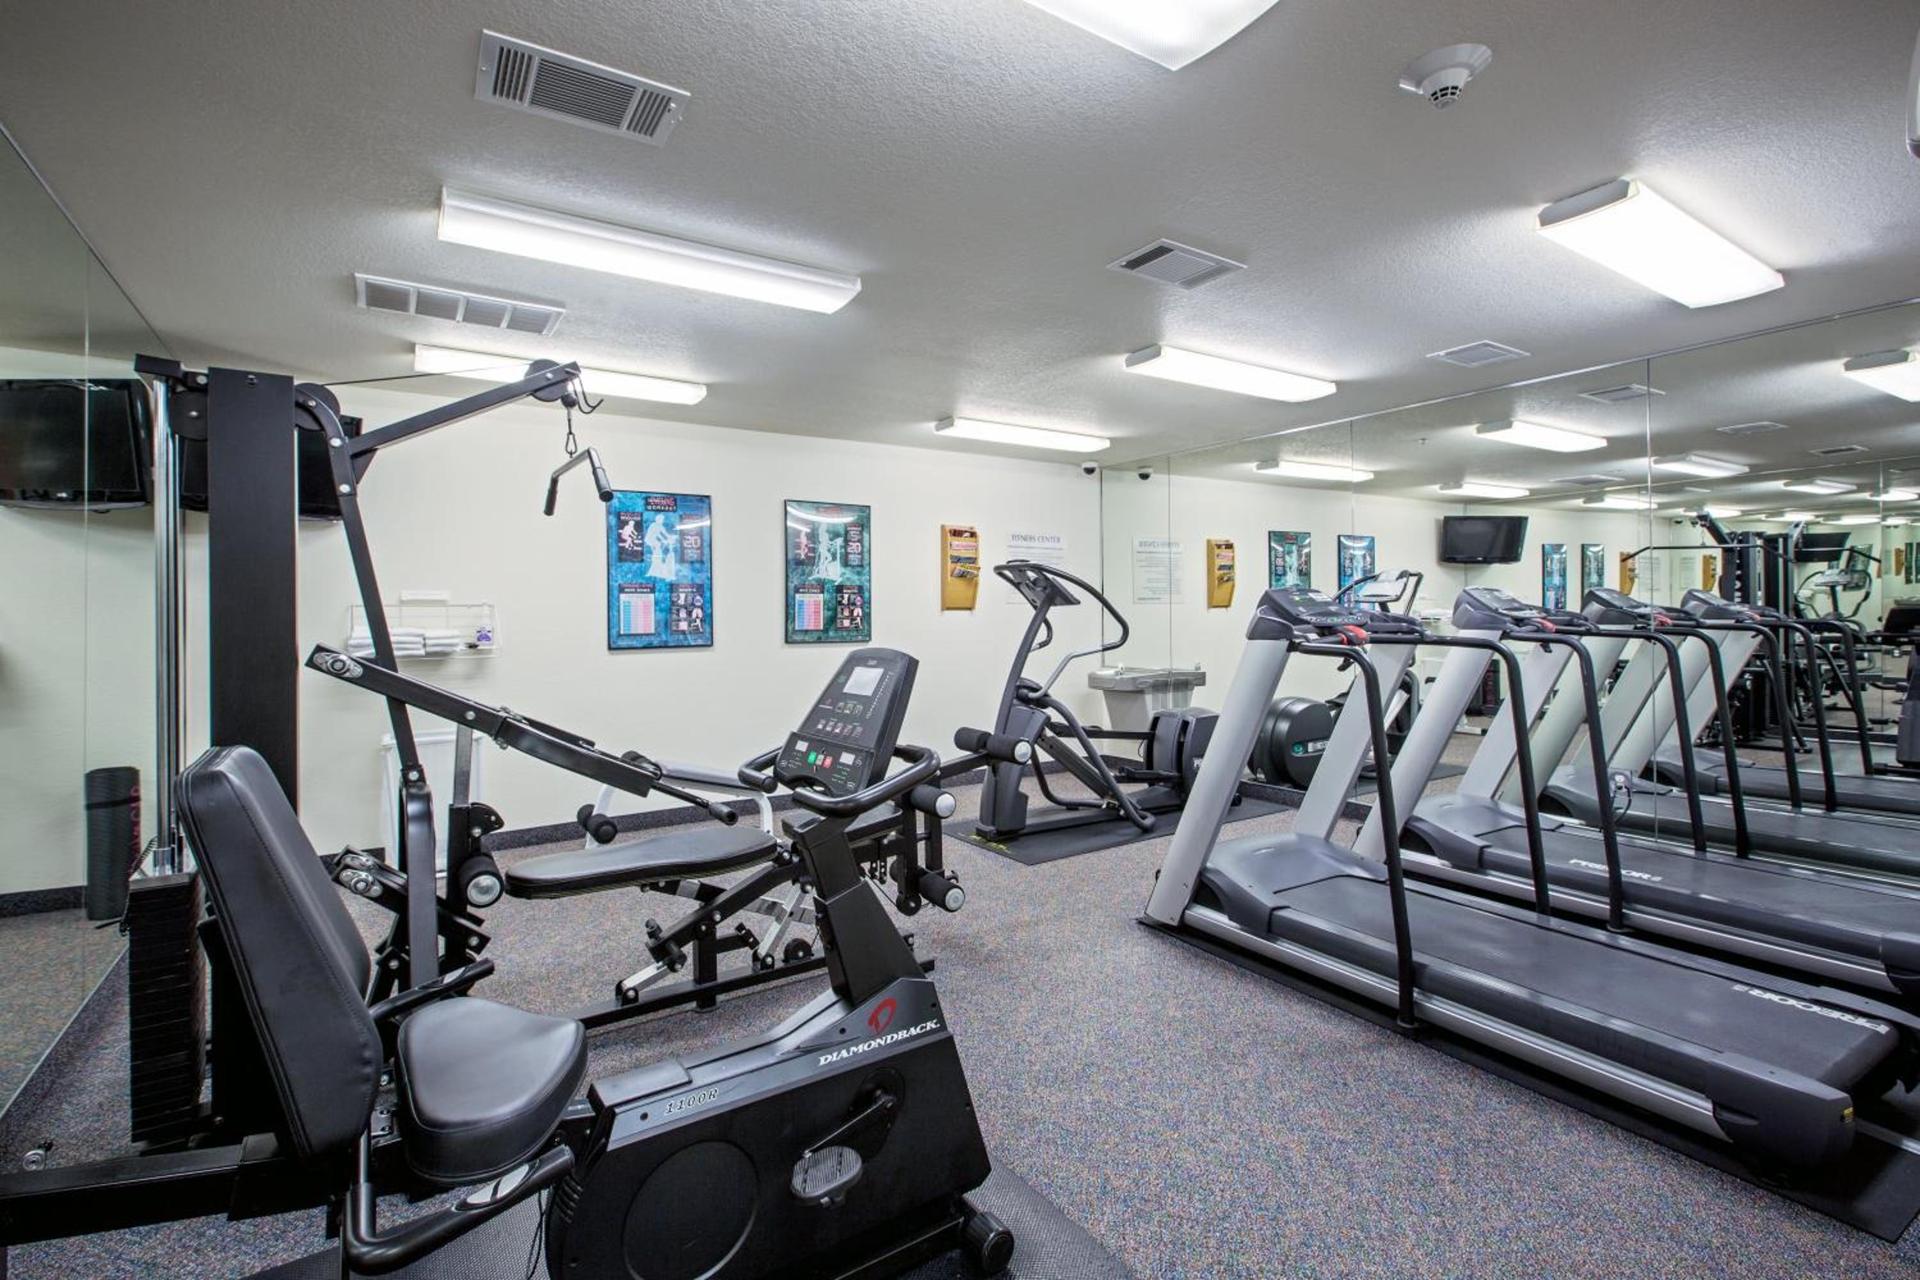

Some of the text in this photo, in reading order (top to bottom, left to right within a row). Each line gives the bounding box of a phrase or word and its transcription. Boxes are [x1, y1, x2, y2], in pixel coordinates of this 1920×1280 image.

[1037, 535, 1061, 544] CENTER
[1568, 858, 1652, 880] PREOR
[1747, 990, 1891, 1035] PRECOR
[664, 1087, 719, 1116] 1100R
